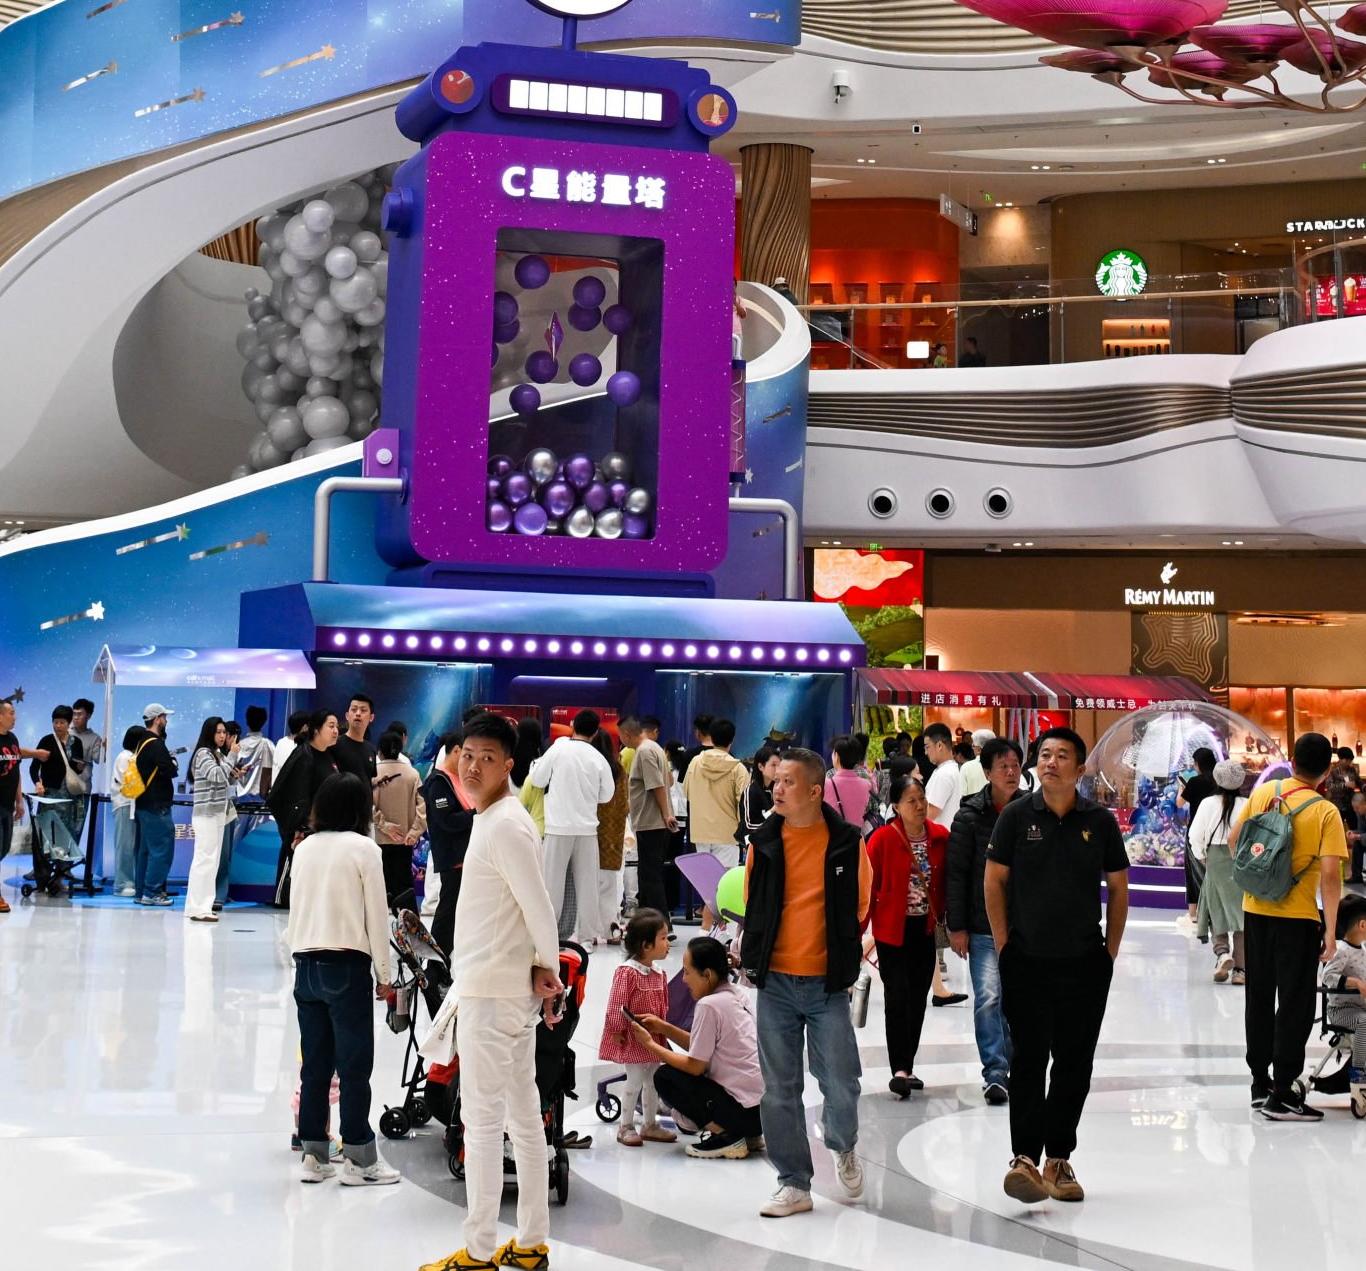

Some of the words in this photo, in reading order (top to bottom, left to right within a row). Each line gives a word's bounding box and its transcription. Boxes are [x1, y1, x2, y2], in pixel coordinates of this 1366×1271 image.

[501, 165, 666, 210] C星能量塔
[920, 692, 1002, 706] 进店消费有礼
